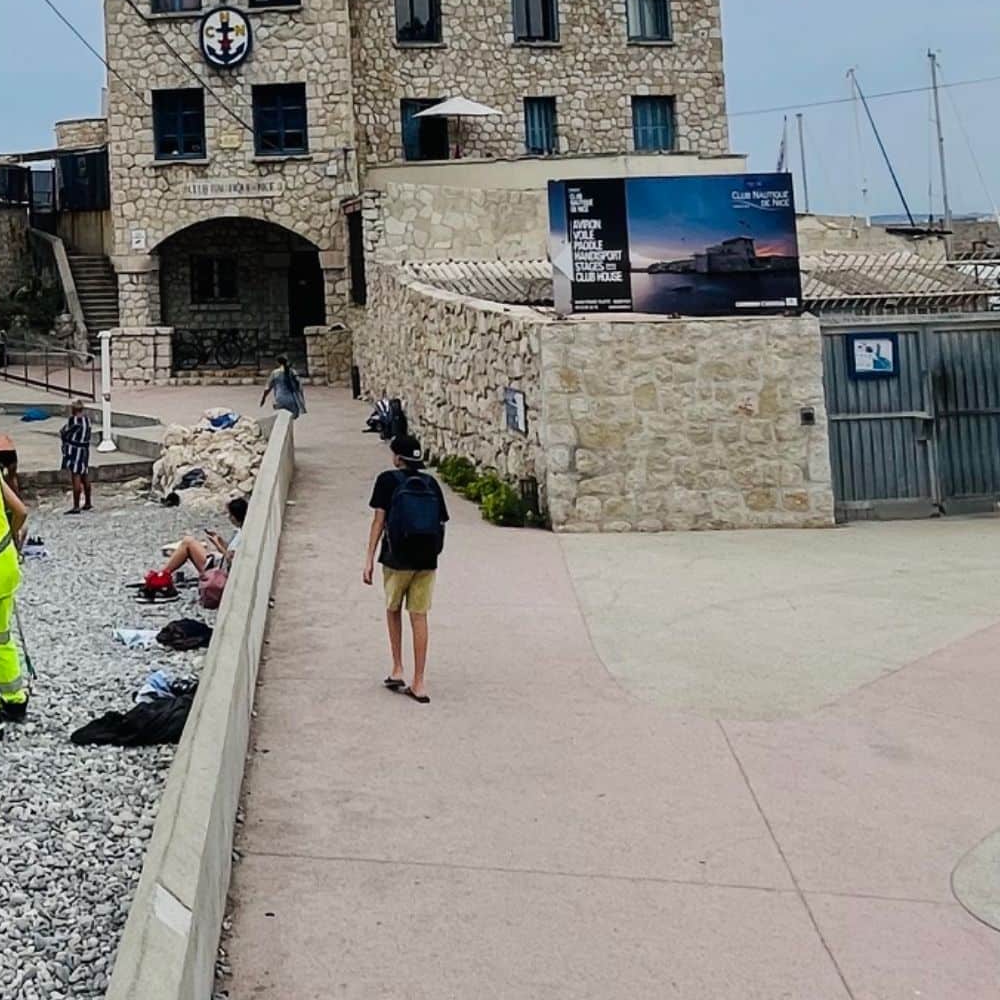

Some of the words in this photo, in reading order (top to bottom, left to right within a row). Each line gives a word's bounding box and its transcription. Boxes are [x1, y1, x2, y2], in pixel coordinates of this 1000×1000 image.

[731, 191, 752, 200] CLUB
[573, 219, 602, 230] AVIRON
[573, 230, 595, 240] VOILE
[573, 240, 603, 250] PADDLE
[574, 261, 605, 272] STAGES
[575, 272, 596, 282] CLUB
[597, 271, 623, 282] HOUSE
